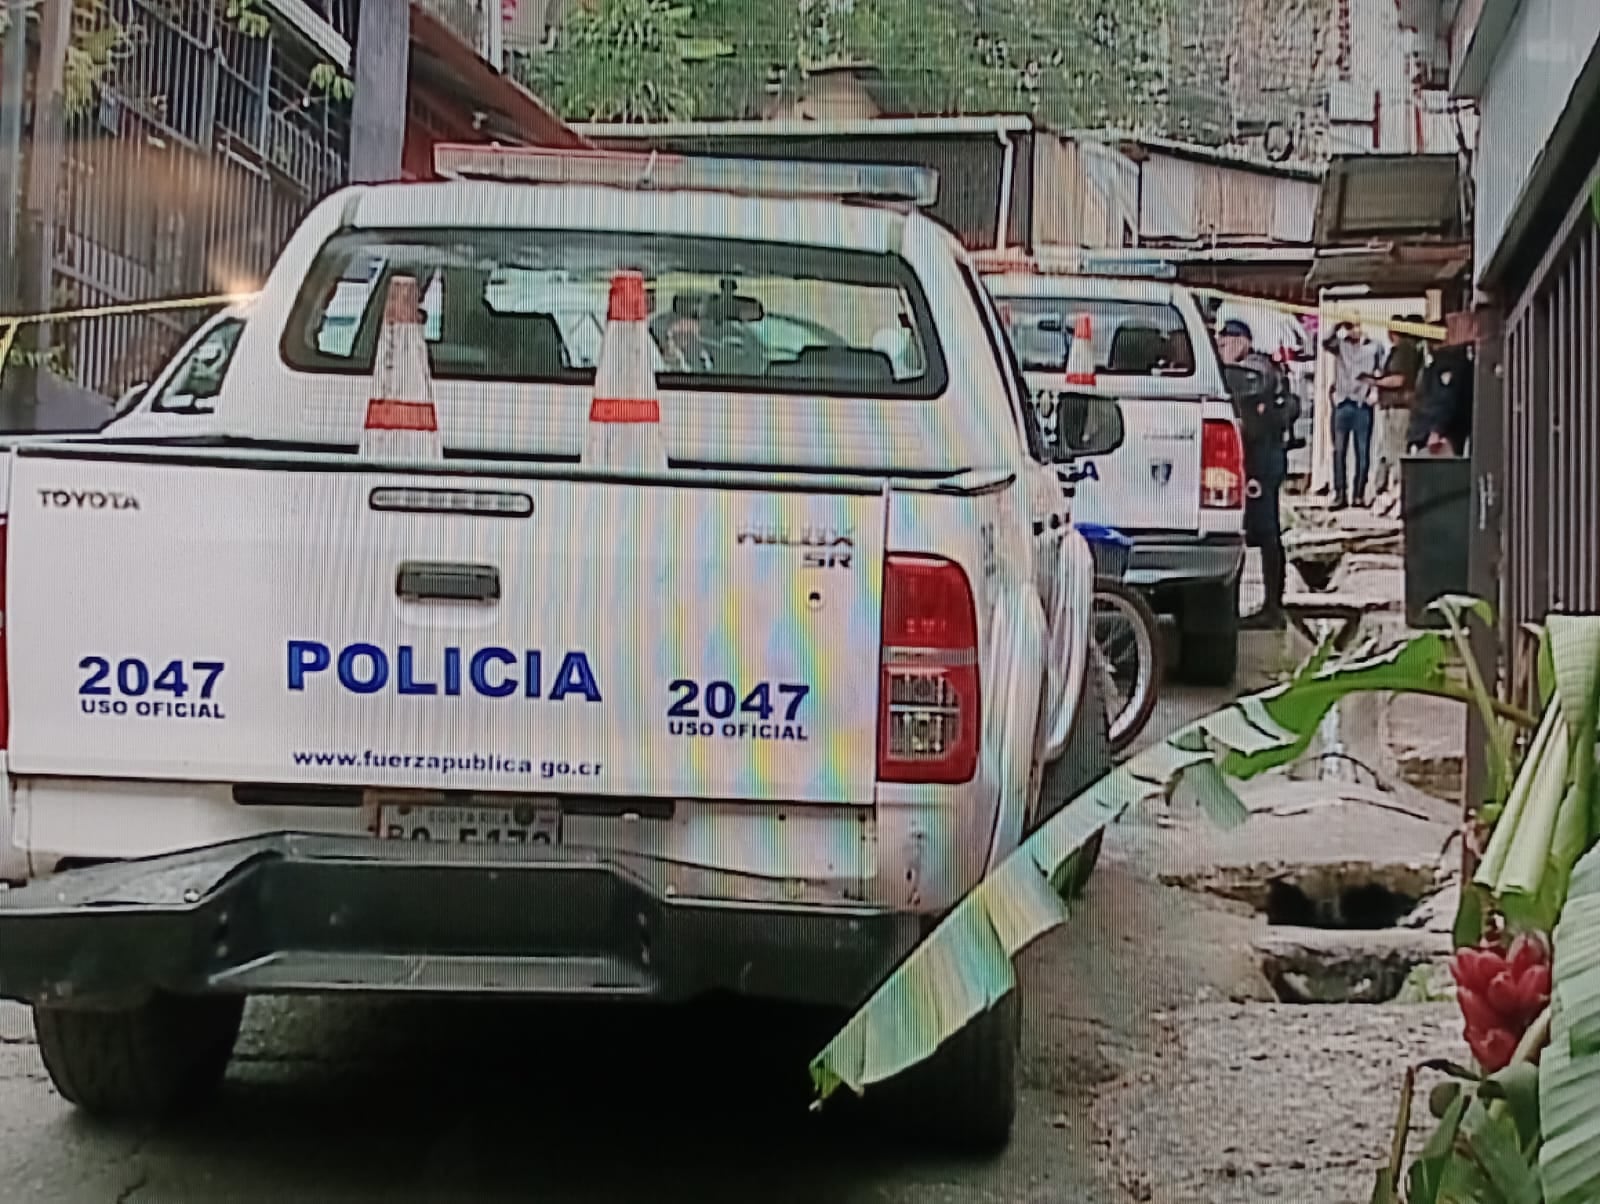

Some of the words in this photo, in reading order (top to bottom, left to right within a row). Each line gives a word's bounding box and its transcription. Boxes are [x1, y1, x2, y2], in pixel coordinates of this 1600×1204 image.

[38, 489, 140, 509] TOYOTA
[802, 552, 853, 568] SR
[79, 656, 225, 699] 2047
[287, 640, 602, 702] POLICIA
[81, 699, 127, 714] USO
[136, 701, 225, 719] OFICIAL
[667, 679, 810, 721] 2047
[669, 721, 714, 736] USO
[722, 723, 808, 741] OFICIAL
